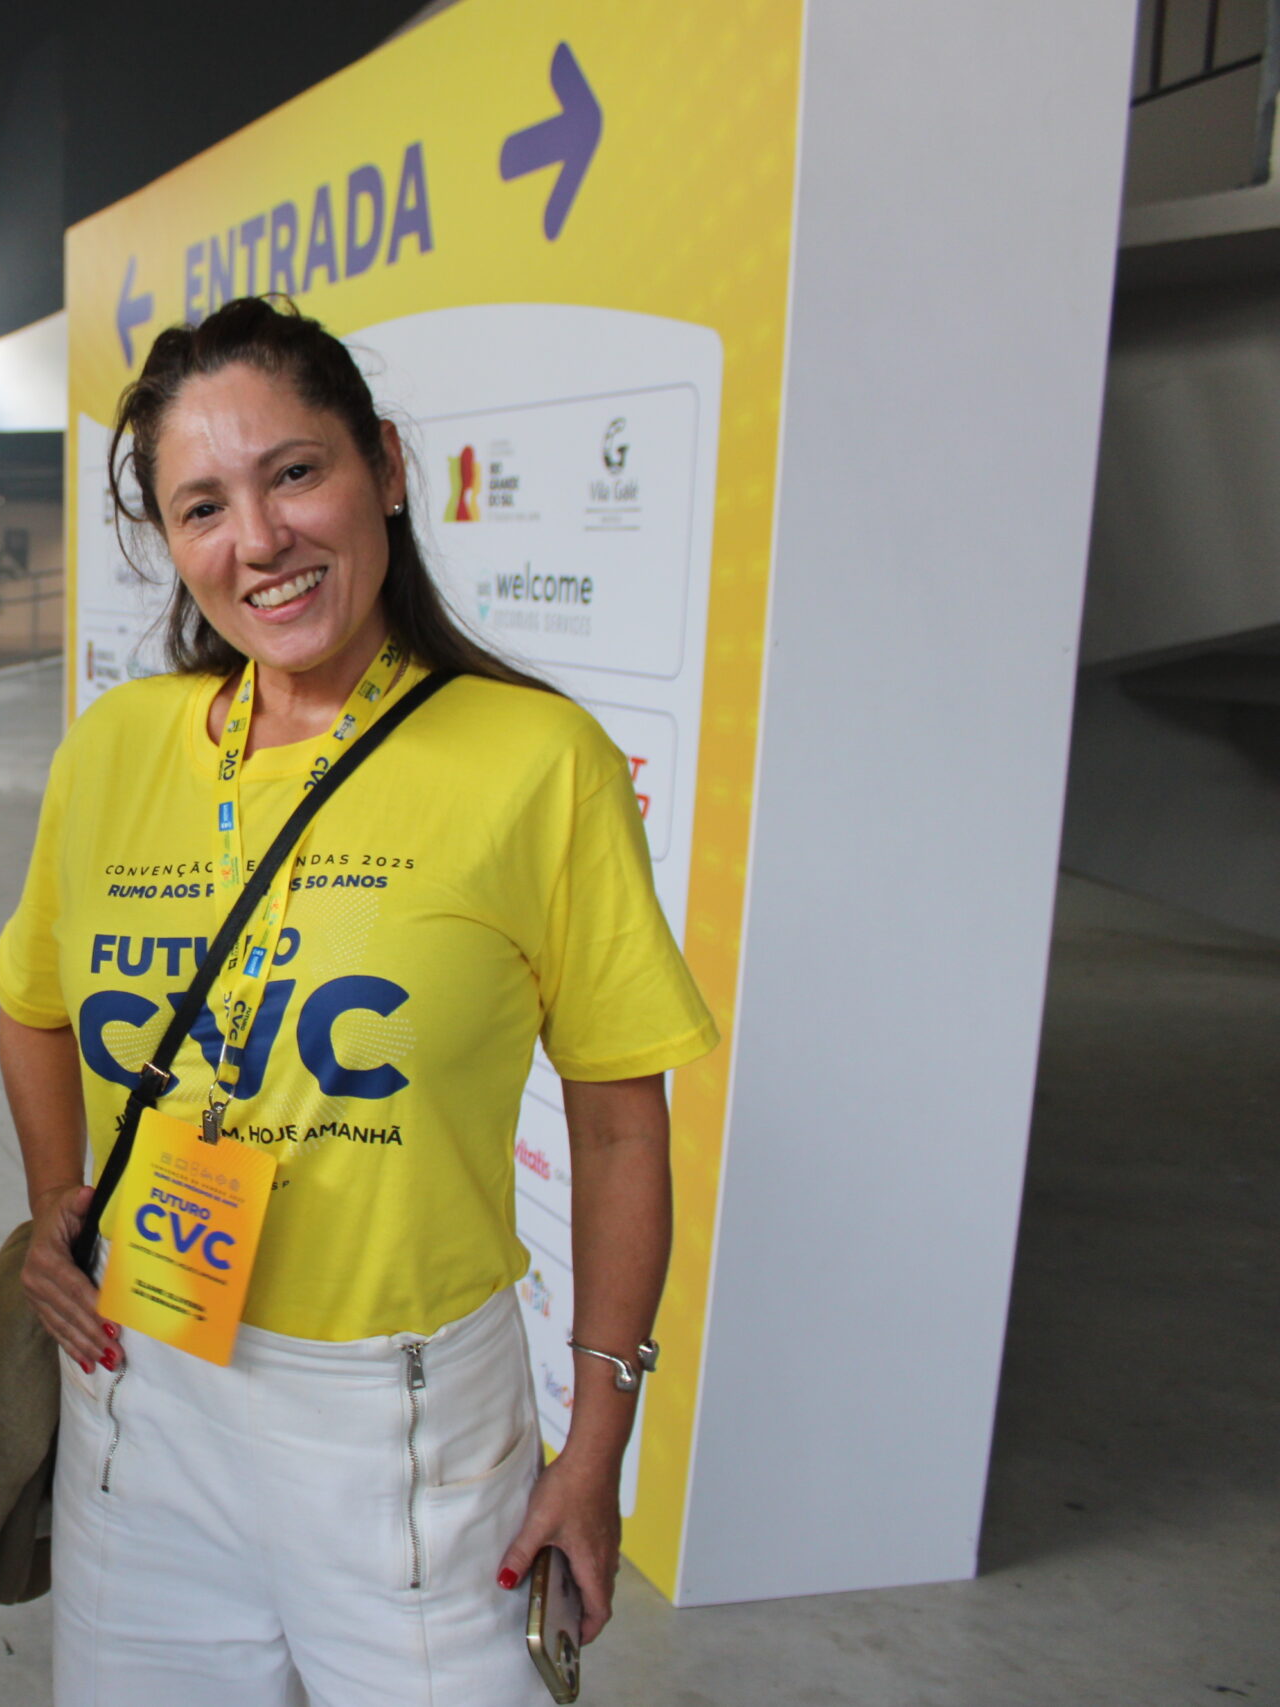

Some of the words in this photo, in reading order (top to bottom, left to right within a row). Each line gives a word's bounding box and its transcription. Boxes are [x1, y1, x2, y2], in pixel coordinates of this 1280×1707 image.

[185, 140, 434, 330] ENTRADA
[496, 560, 593, 605] welcome
[223, 749, 239, 781] CVC
[296, 854, 349, 868] NDAS
[362, 855, 415, 869] 2025
[108, 884, 157, 899] RUMO
[160, 884, 200, 899] AOS
[305, 875, 328, 889] 50
[331, 874, 388, 889] ANOS
[91, 926, 302, 977] FUTO
[79, 974, 410, 1100] CVC
[229, 1000, 247, 1041] CVC
[249, 1124, 298, 1144] HOJE
[304, 1122, 403, 1146] AMANHÃ
[150, 1187, 212, 1220] FUTURO
[134, 1203, 237, 1271] CVC
